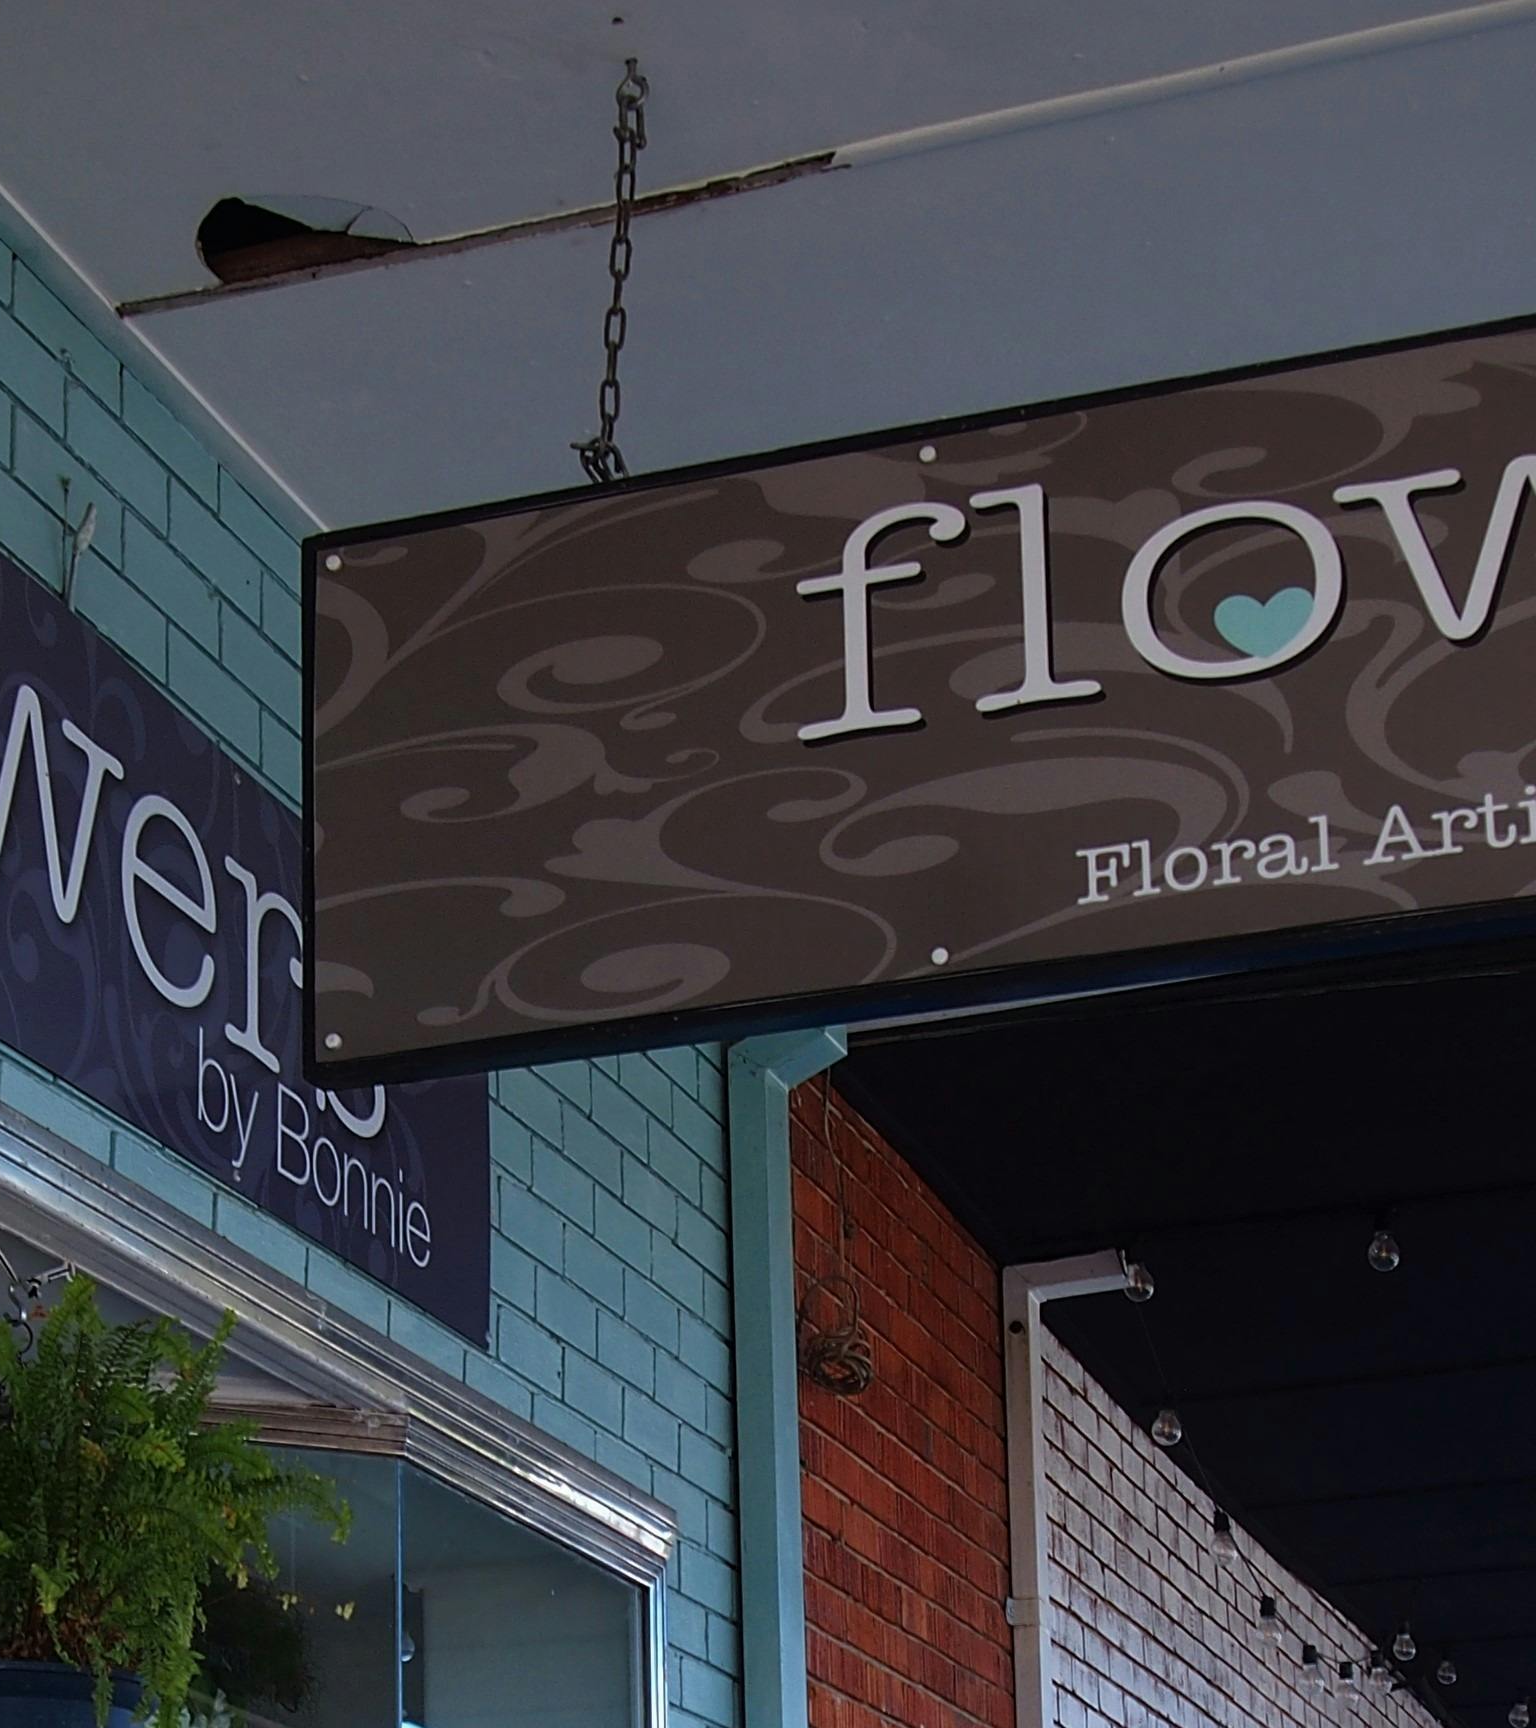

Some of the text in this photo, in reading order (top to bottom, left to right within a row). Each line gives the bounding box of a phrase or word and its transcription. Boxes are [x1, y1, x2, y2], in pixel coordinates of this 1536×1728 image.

[1075, 812, 1340, 905] Floral
[197, 1025, 432, 1268] by Bonnie
